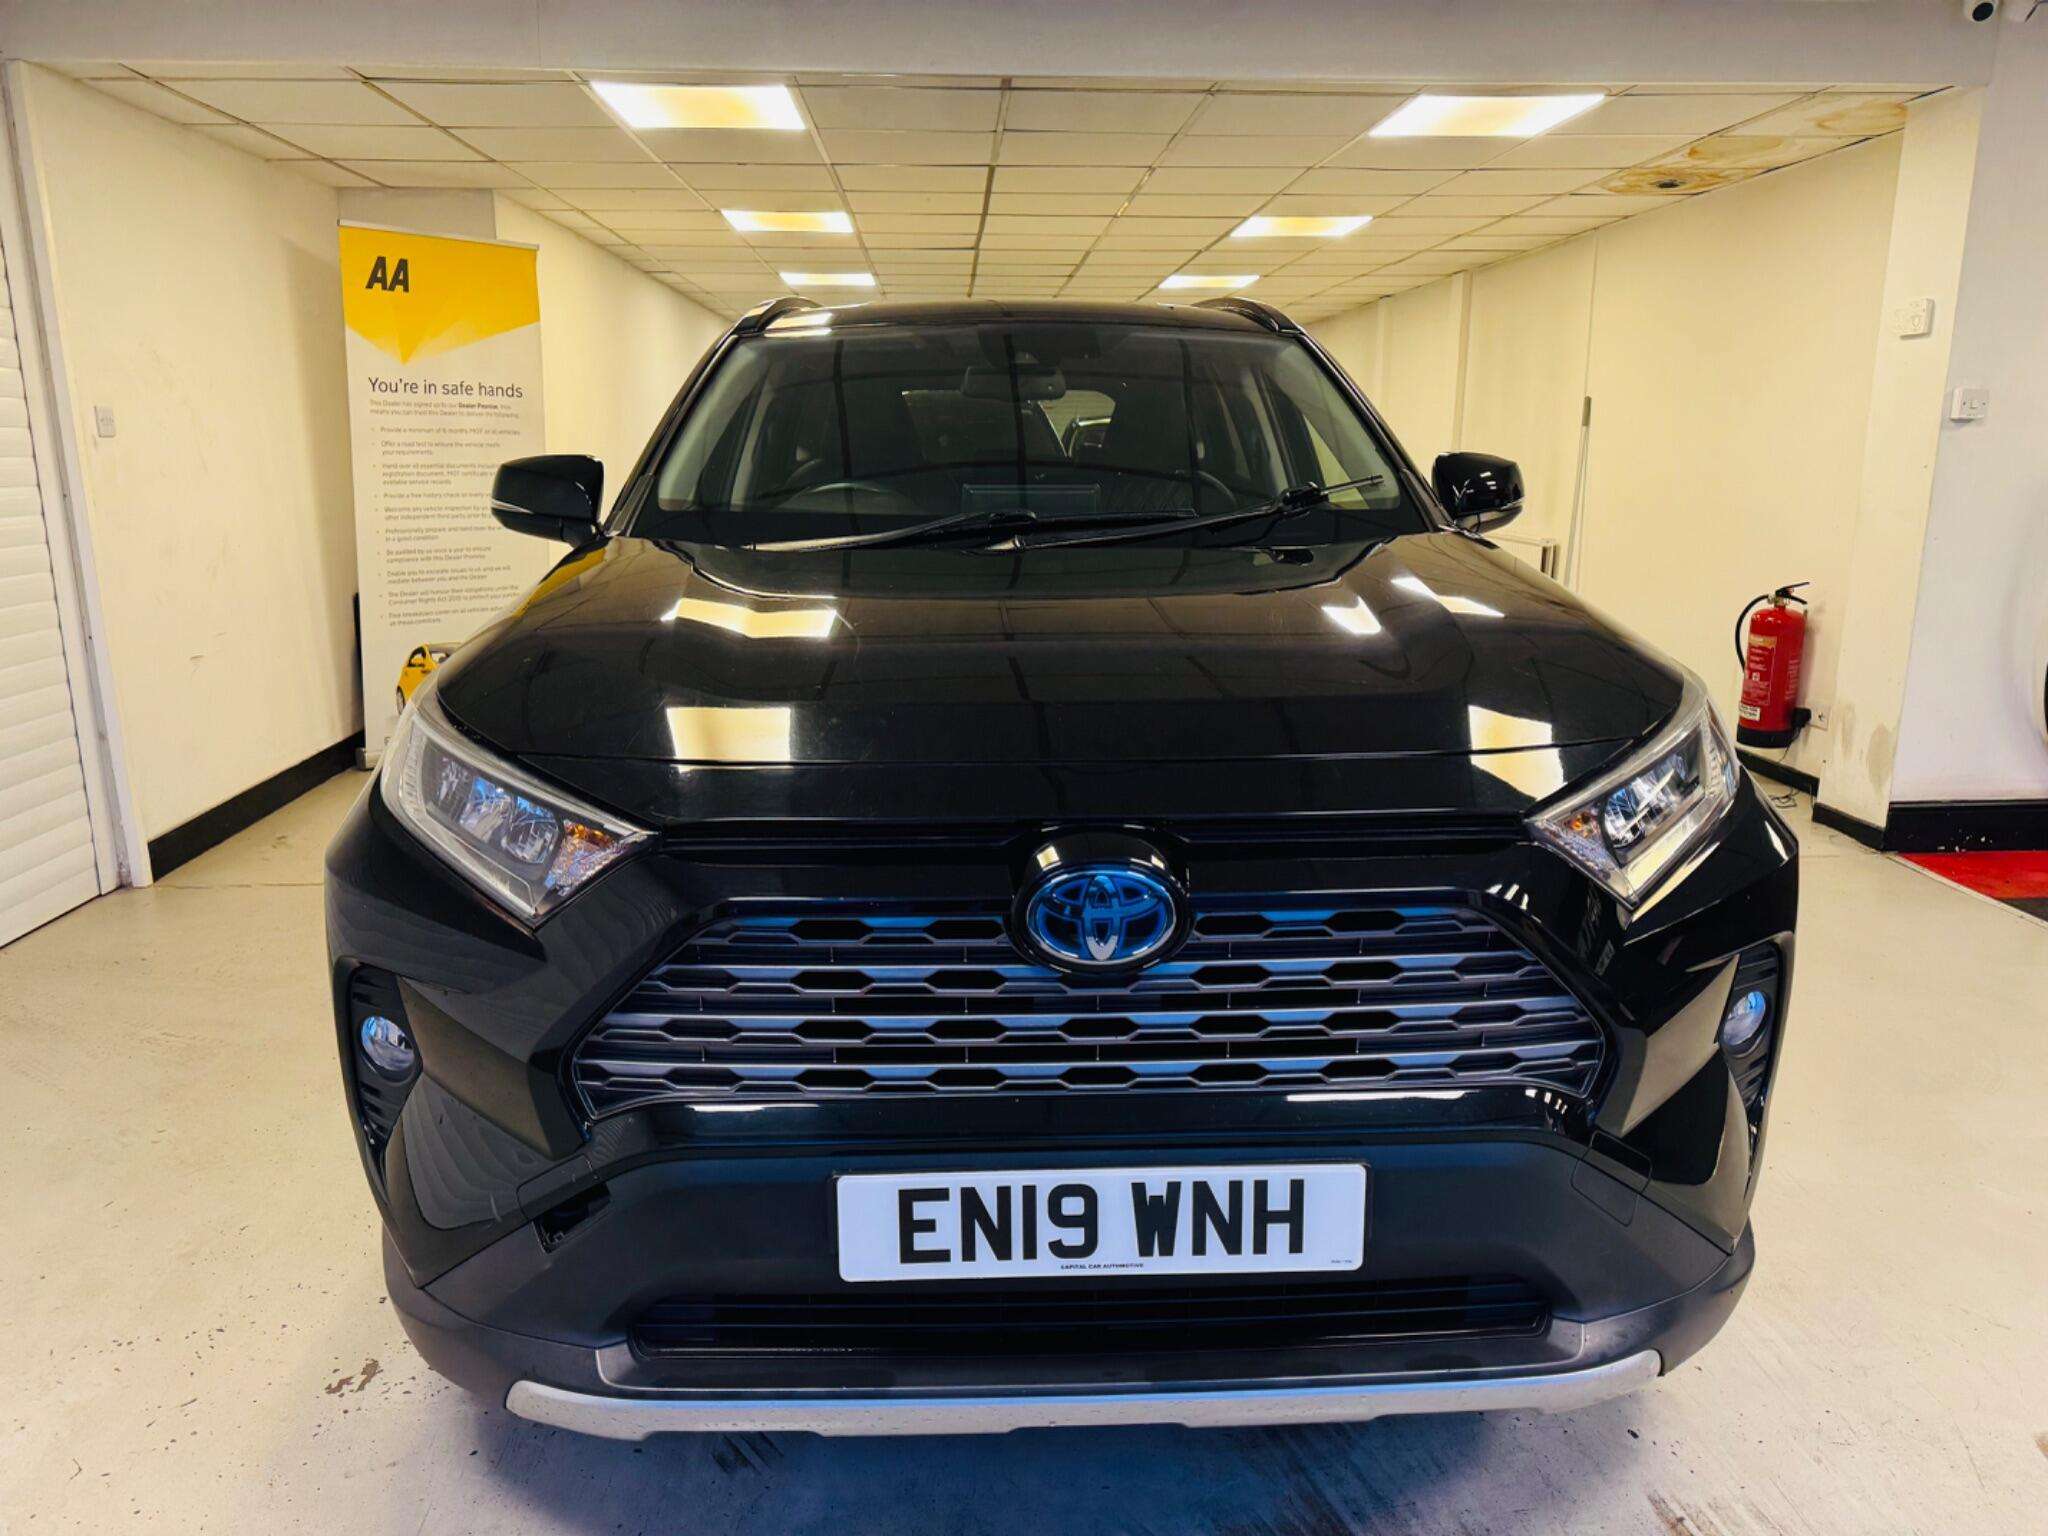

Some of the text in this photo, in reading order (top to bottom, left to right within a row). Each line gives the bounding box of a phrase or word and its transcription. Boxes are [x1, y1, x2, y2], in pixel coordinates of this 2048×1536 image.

[366, 256, 410, 293] AA
[368, 376, 523, 398] You're in safe hands
[1131, 1178, 1305, 1258] WNH
